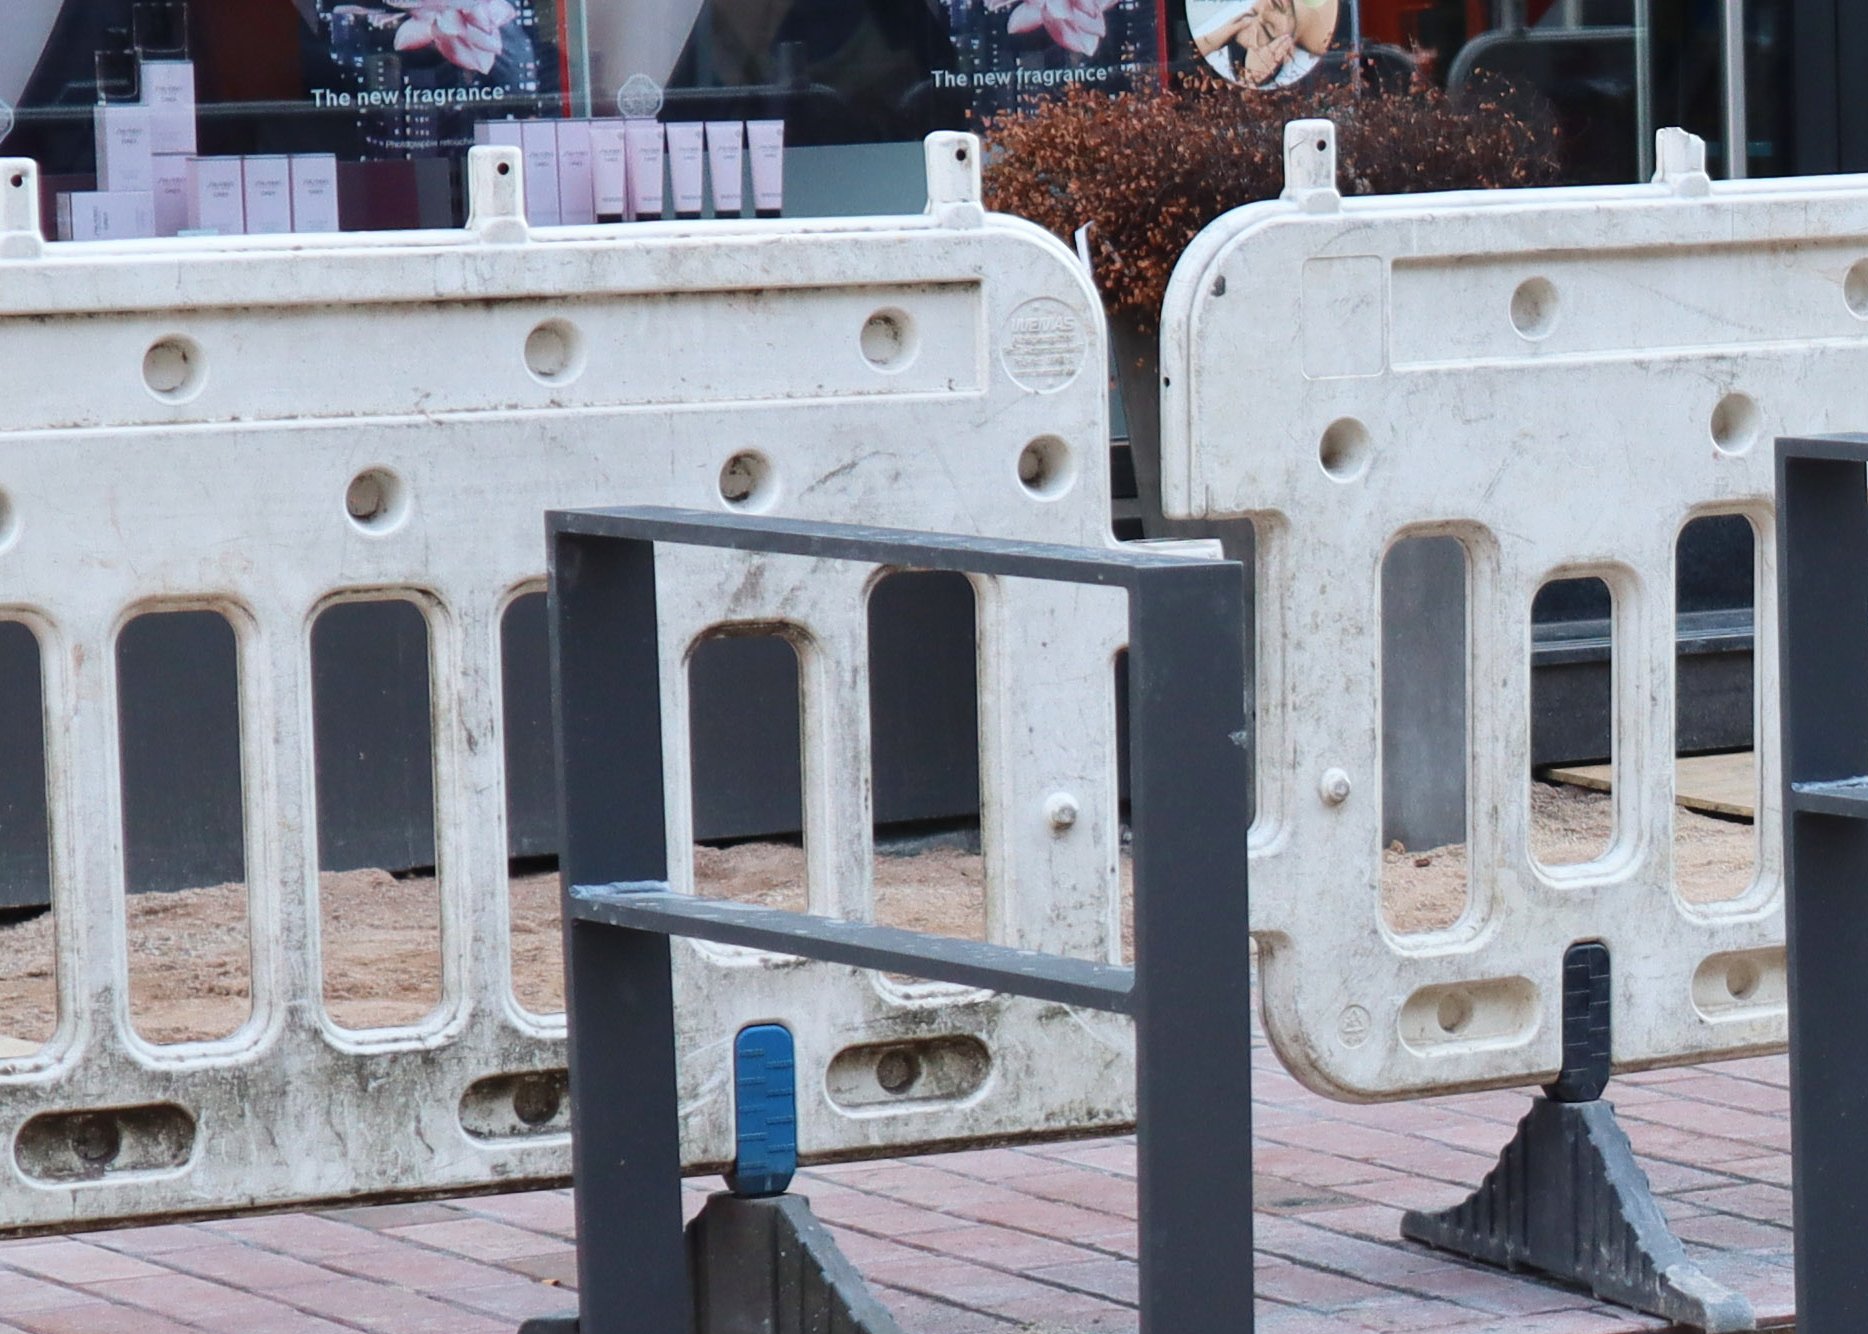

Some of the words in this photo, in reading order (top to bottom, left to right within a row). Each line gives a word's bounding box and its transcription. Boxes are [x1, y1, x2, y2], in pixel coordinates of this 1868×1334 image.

[931, 69, 968, 88] The
[973, 71, 1011, 86] new
[310, 88, 351, 108] The
[357, 90, 399, 106] new
